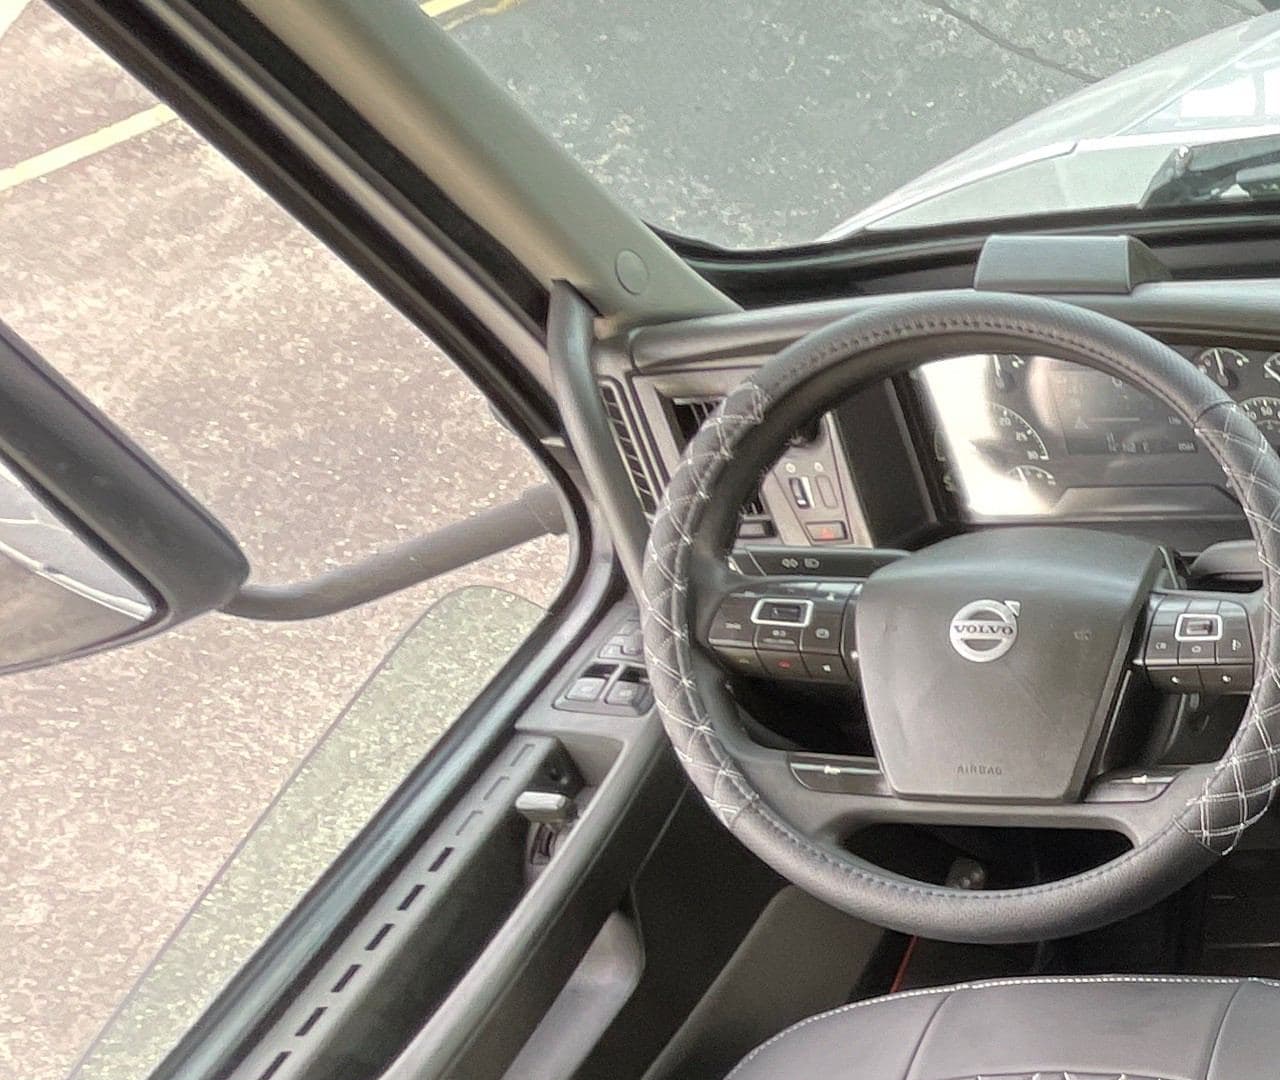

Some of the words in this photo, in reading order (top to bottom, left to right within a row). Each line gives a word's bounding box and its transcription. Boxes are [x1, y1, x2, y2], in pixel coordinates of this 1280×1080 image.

[1260, 406, 1273, 416] 50
[953, 624, 1014, 635] VOLVO
[957, 764, 1002, 776] AIRBAG
